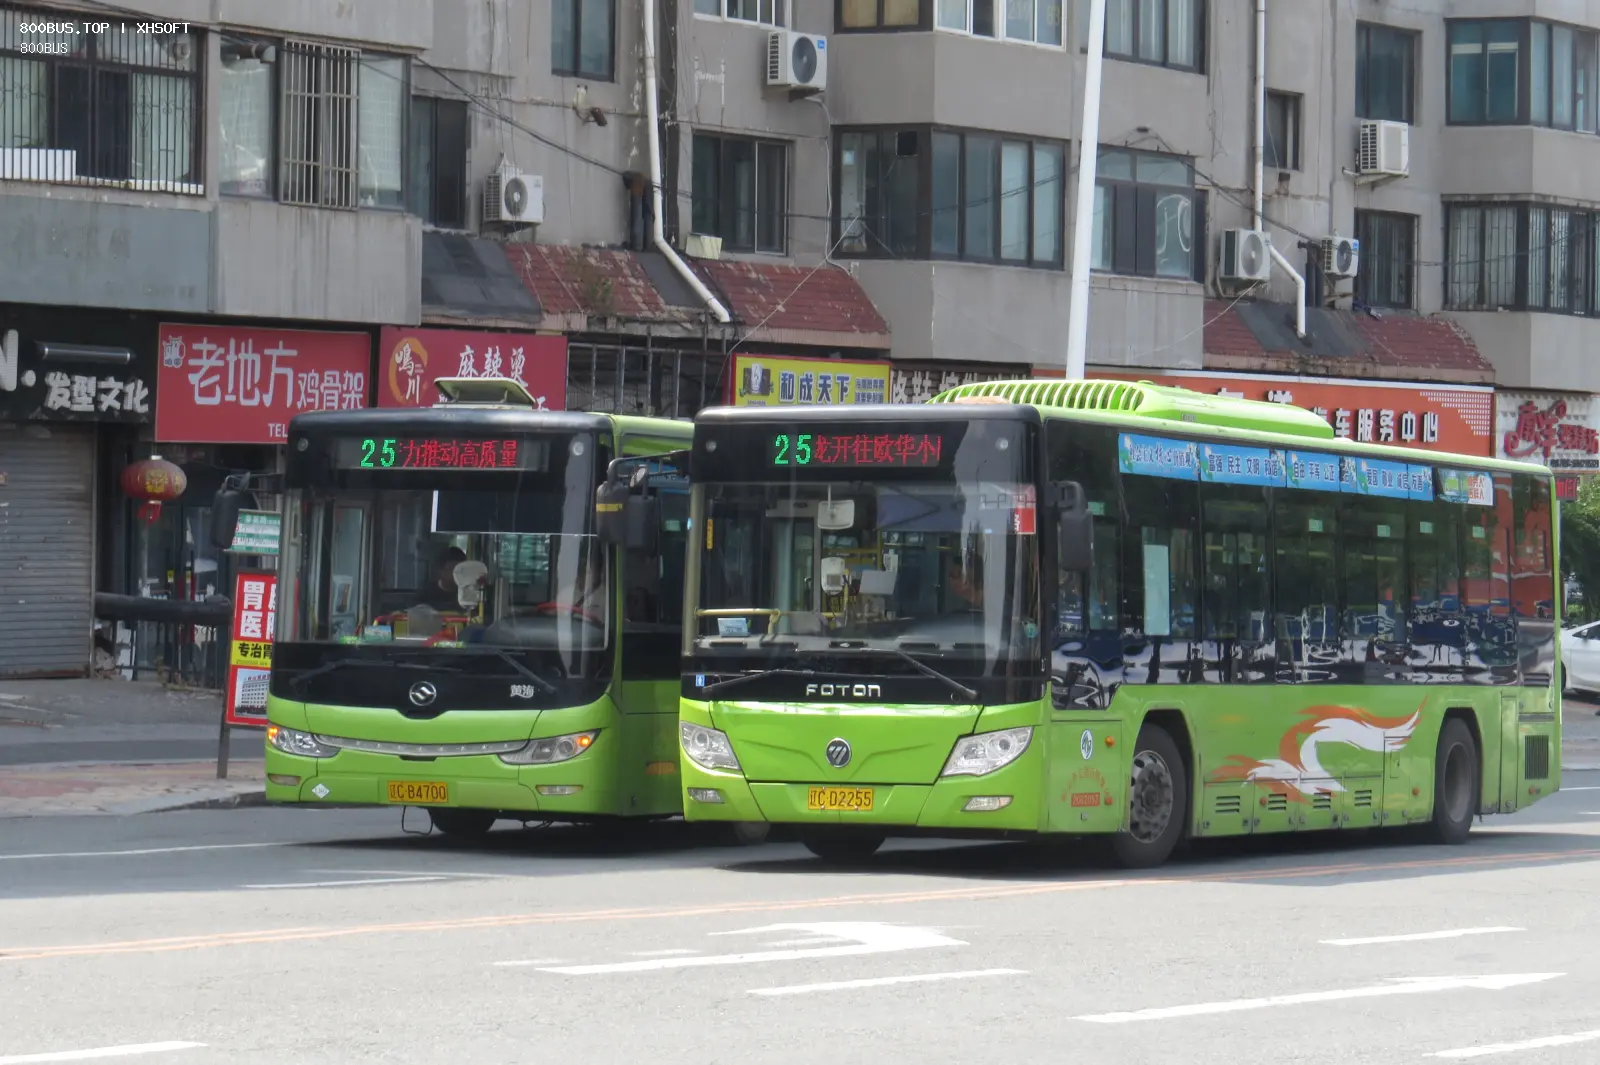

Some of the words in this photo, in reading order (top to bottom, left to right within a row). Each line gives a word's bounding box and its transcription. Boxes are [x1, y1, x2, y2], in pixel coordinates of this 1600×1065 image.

[44, 371, 149, 413] 发型文化
[779, 370, 851, 404] 和成天下
[268, 423, 289, 438] TEL
[360, 439, 396, 468] 25
[399, 439, 518, 468] 力推动高质量
[774, 434, 812, 465] 25
[814, 434, 942, 465] 龙开往欧华小
[510, 684, 534, 698] 黄海
[805, 684, 881, 697] FOTON
